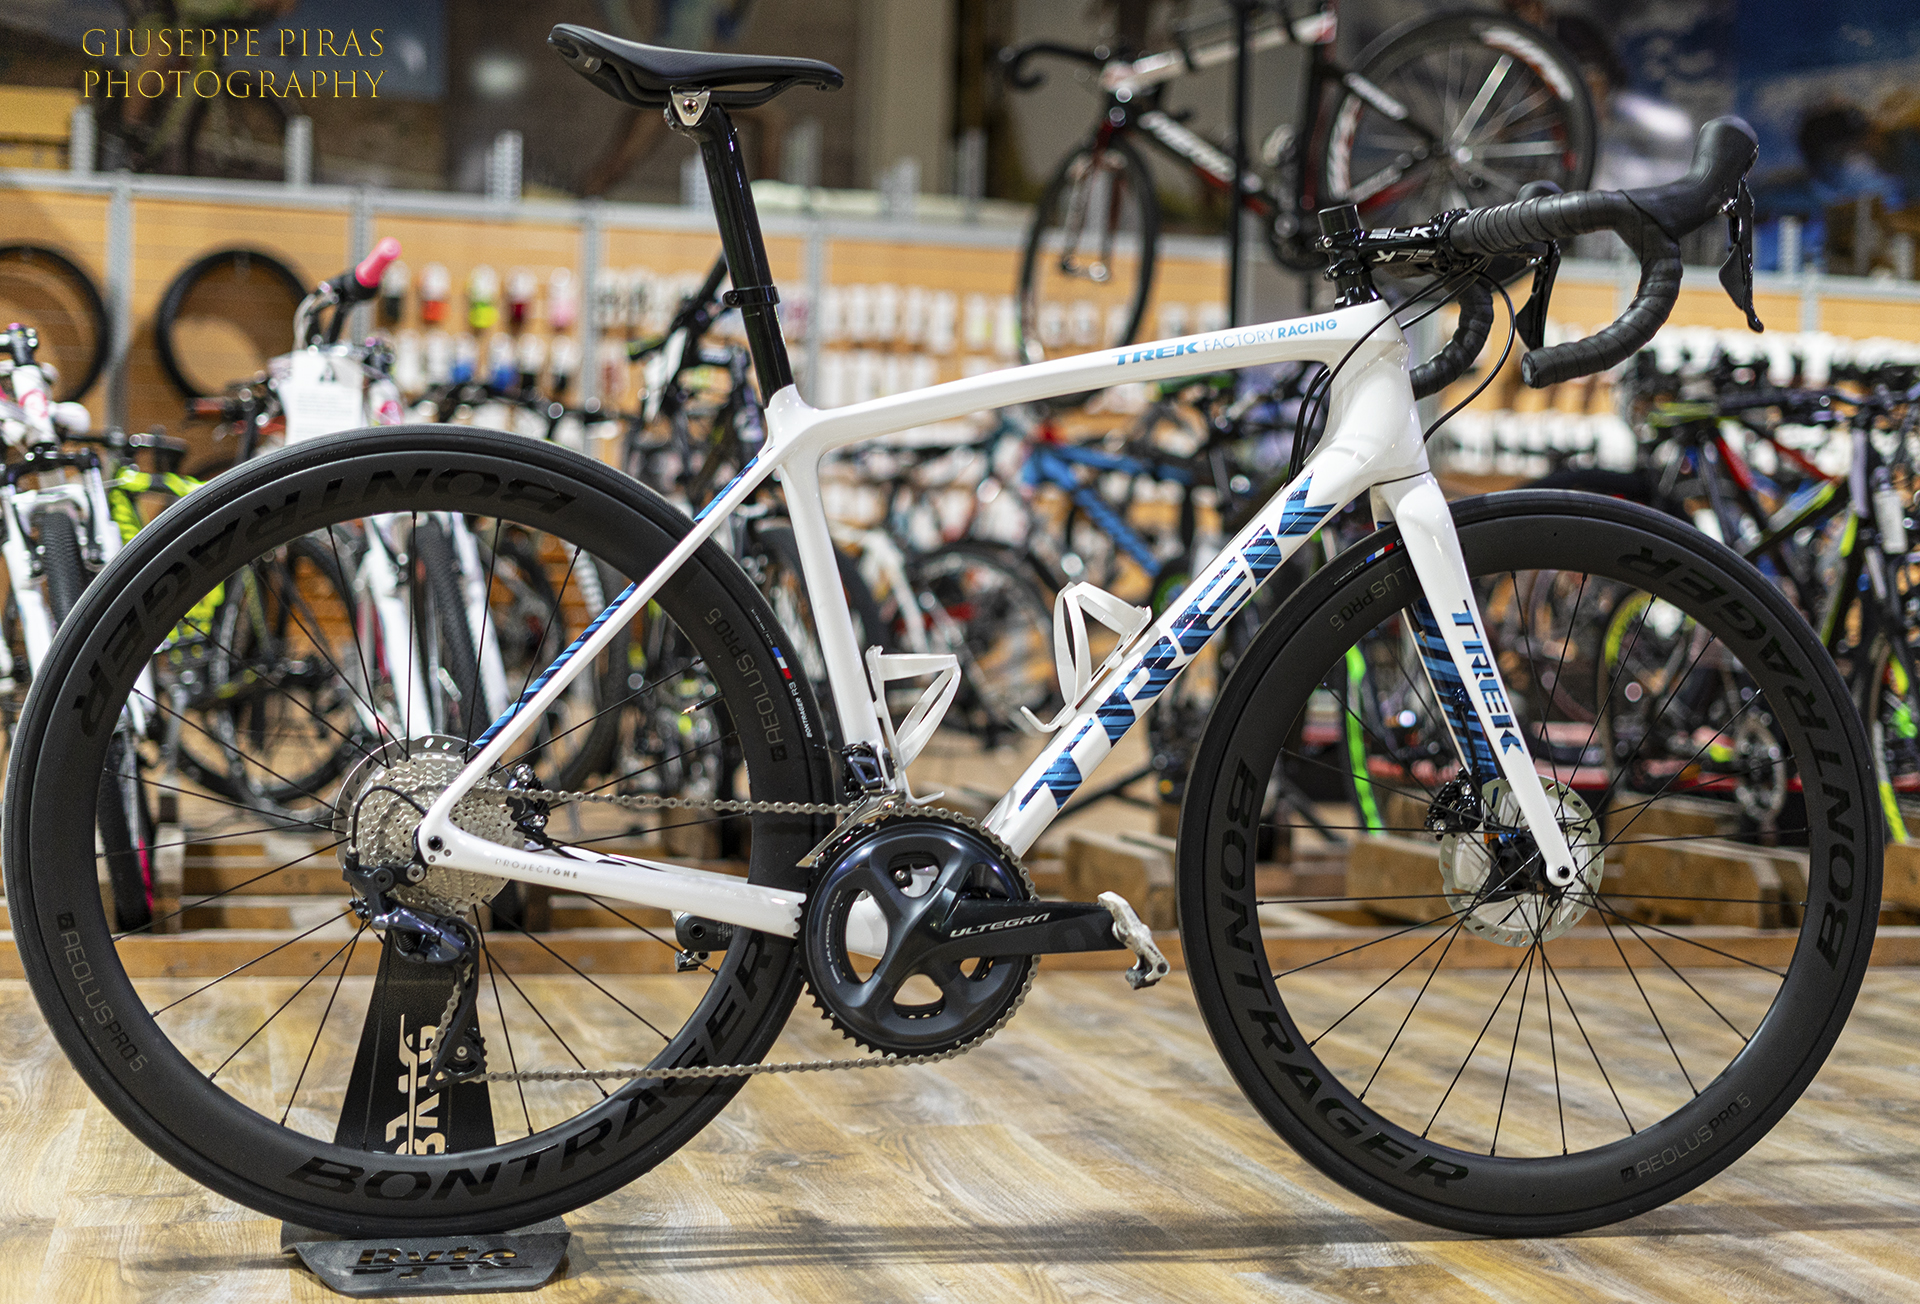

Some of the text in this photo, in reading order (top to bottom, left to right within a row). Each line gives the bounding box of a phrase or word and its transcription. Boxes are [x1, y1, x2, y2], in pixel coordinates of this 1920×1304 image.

[1111, 341, 1199, 366] TREK
[73, 467, 578, 738] BONTRAGER
[1018, 467, 1339, 812] TREK
[1451, 599, 1525, 756] TREK
[1617, 546, 1856, 971] BONTRAGER
[950, 912, 1051, 938] ULTEGRA
[1220, 757, 1469, 1190] BONTRAGER
[286, 932, 766, 1202] BONTRAGER
